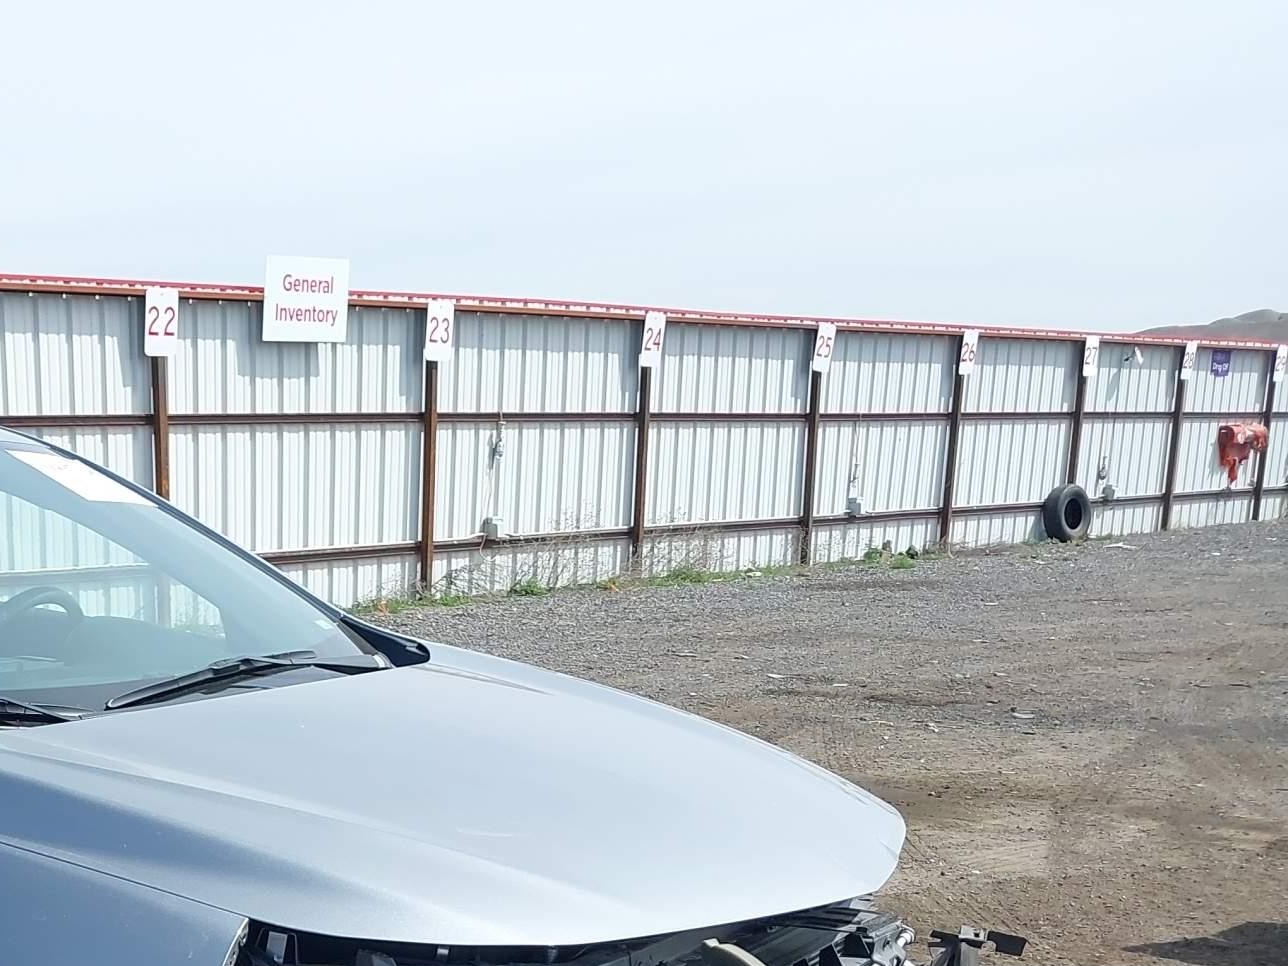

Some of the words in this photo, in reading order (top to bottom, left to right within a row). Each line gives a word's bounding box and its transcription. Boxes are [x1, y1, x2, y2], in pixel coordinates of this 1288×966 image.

[282, 274, 333, 295] General
[148, 306, 175, 336] 22
[274, 304, 338, 326] Inventory
[429, 316, 450, 344] 23
[644, 327, 661, 352] 24
[816, 335, 832, 358] 25
[961, 342, 975, 361] 26
[1084, 347, 1098, 365] 27
